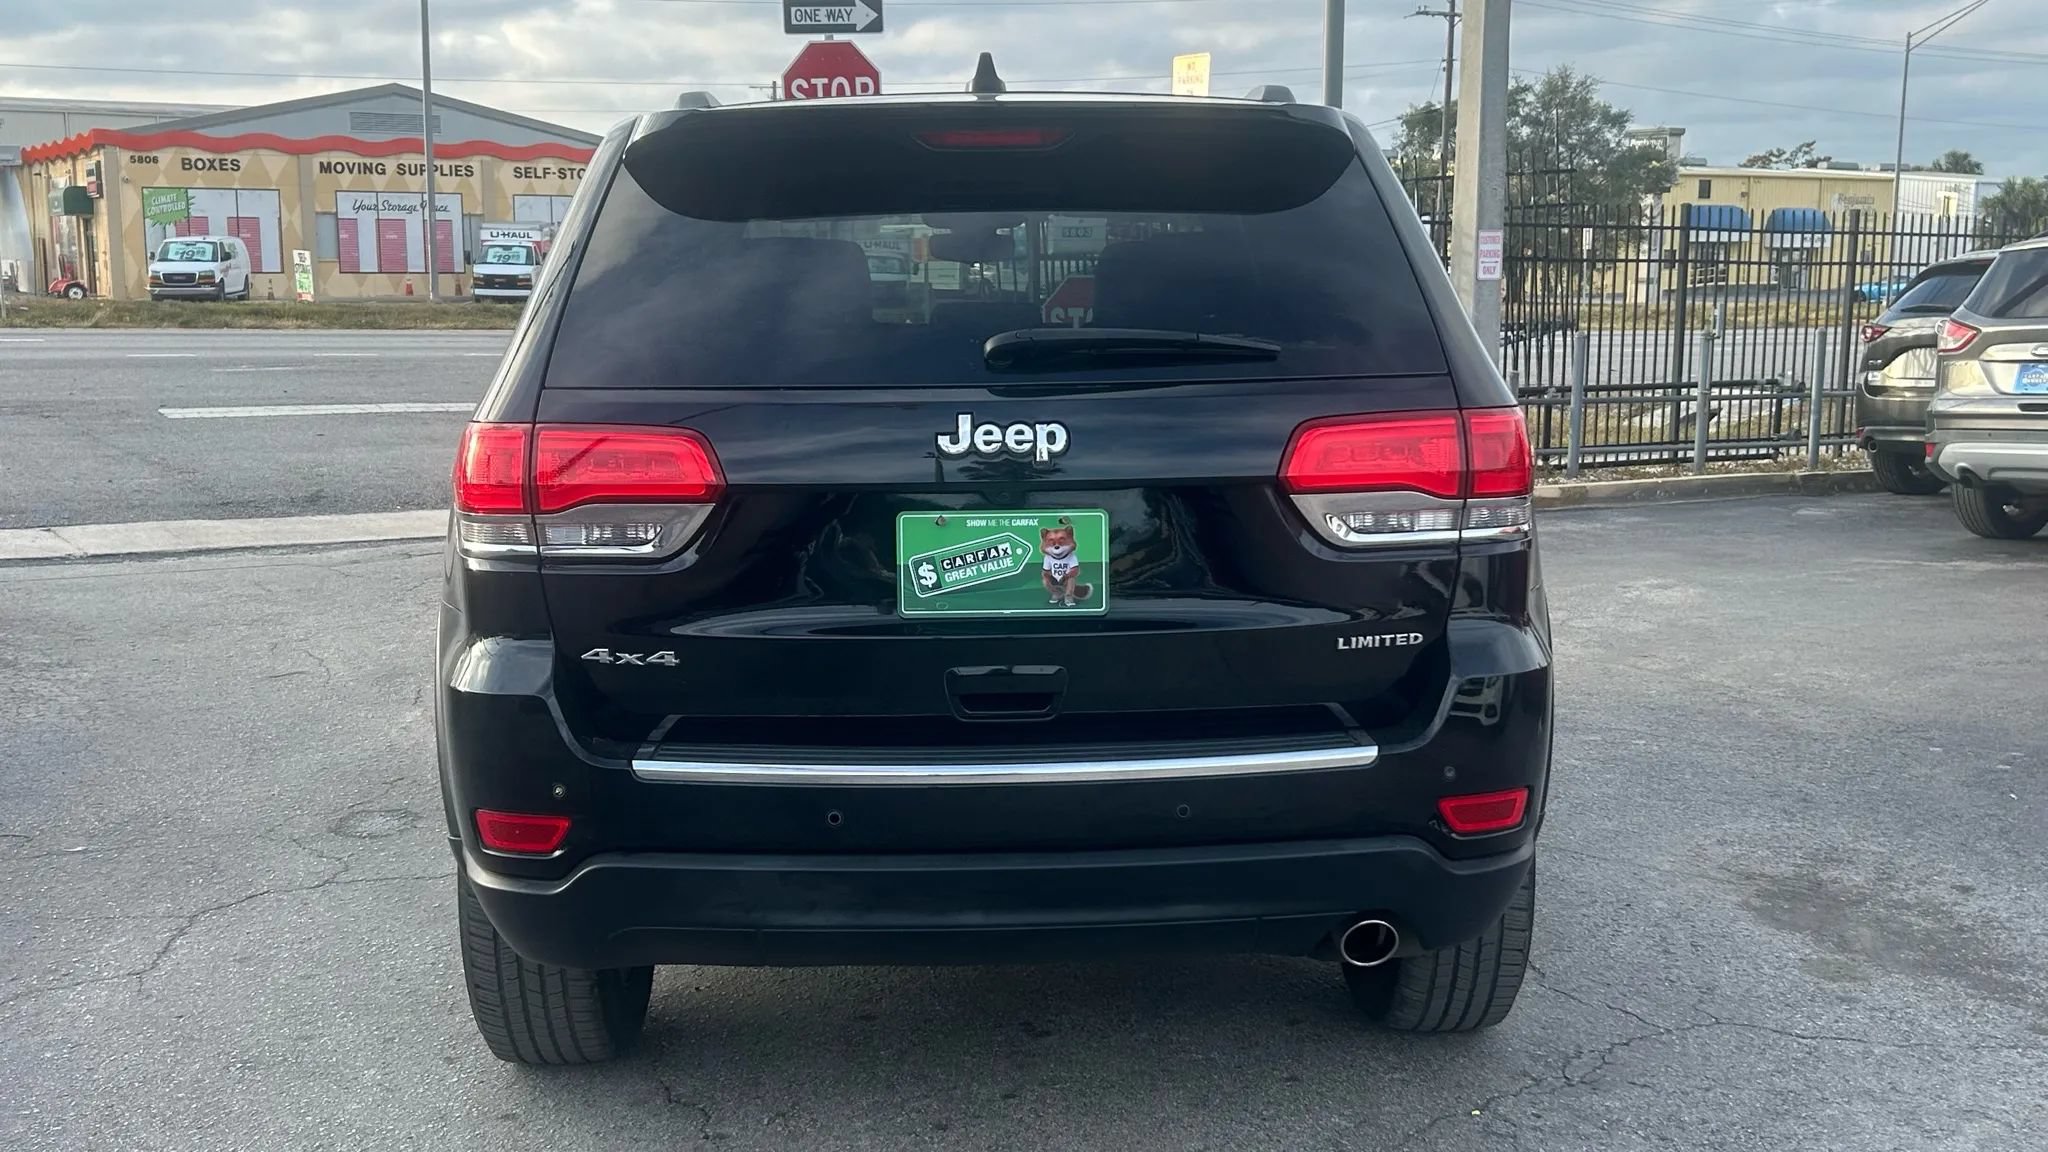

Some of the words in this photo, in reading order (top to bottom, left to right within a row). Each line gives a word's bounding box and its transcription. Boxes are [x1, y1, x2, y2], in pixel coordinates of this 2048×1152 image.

[794, 8, 821, 23] ONE
[825, 8, 853, 22] WAY
[129, 155, 159, 165] 5806
[181, 157, 241, 172] BOXES
[319, 161, 387, 176] MOVING
[151, 193, 177, 205] CLIMATE
[352, 199, 378, 214] Your
[380, 199, 419, 214] Storage
[146, 202, 186, 216] CONTROLLED
[490, 231, 533, 239] U-HAUL
[937, 414, 1068, 462] Jeep
[966, 519, 987, 527] SHOW
[1000, 518, 1011, 526] THE
[1011, 518, 1039, 526] CARFAX
[942, 545, 1011, 570] CARFAX
[944, 566, 978, 583] GREAT
[980, 557, 1015, 574] VALUE
[1336, 632, 1424, 650] LIMITED
[580, 648, 680, 667] 4x4
